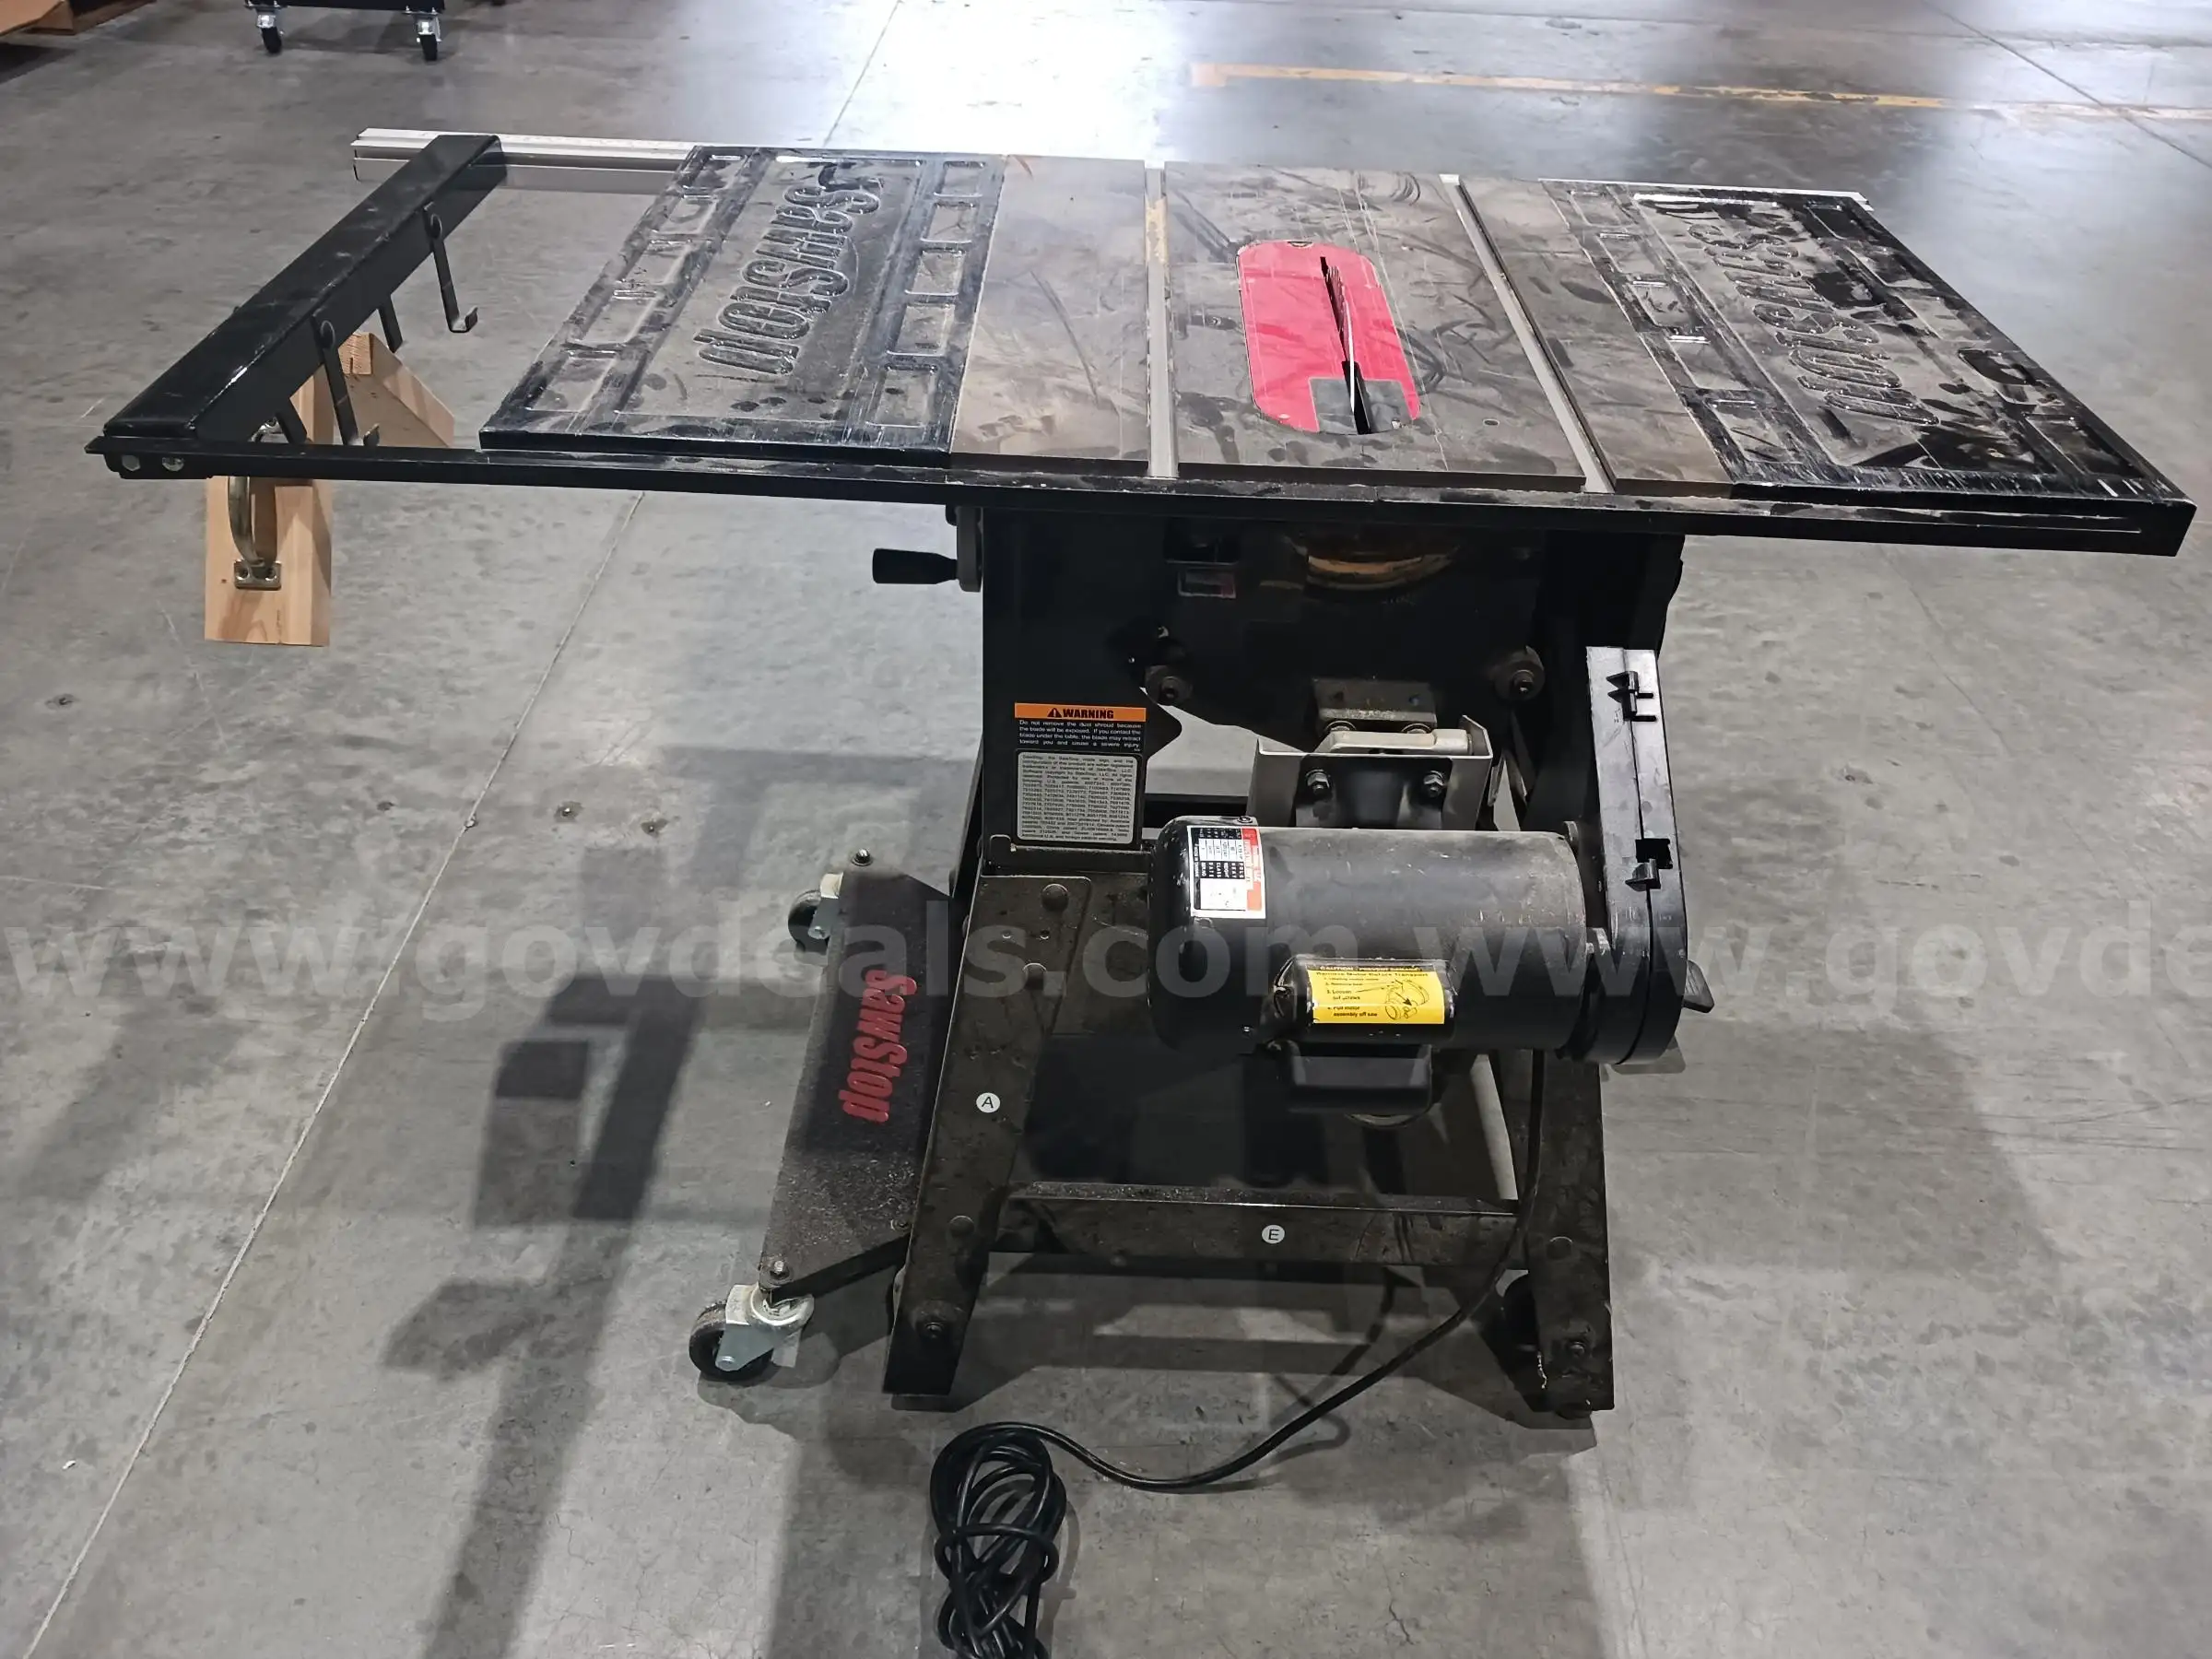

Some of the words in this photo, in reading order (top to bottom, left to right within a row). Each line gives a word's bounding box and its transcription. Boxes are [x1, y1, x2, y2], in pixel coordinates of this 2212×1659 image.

[1063, 709, 1114, 719] WARNING
[839, 969, 918, 1123] SawStop
[982, 1096, 994, 1109] A
[1268, 1229, 1280, 1241] E
